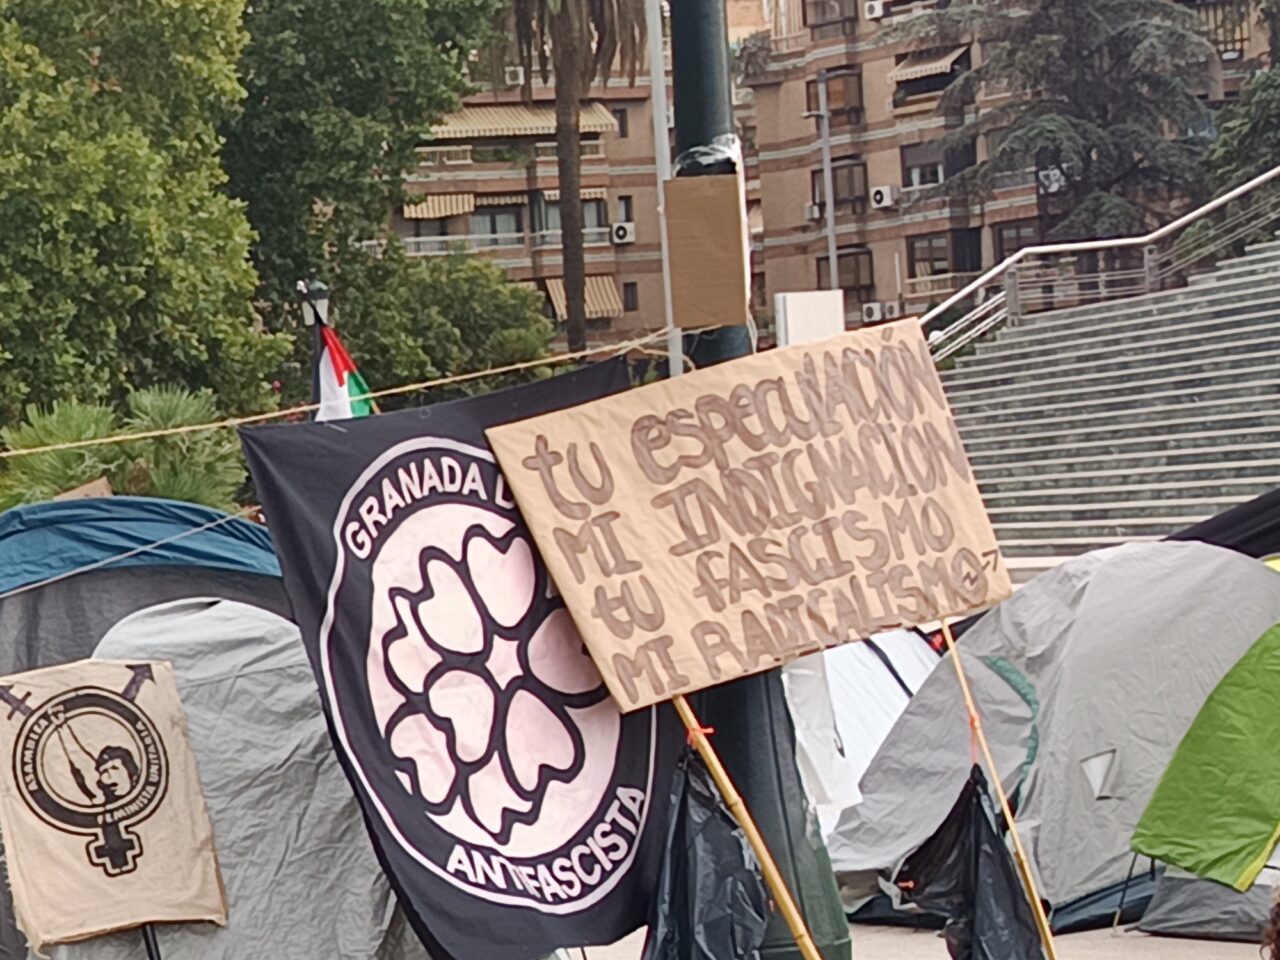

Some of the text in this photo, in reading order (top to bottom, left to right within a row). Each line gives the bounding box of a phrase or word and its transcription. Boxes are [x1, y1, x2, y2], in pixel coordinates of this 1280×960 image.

[345, 456, 488, 559] GRANADA
[552, 511, 644, 585] MI
[612, 634, 690, 705] MI
[446, 786, 645, 902] ANTIFASCISTA
